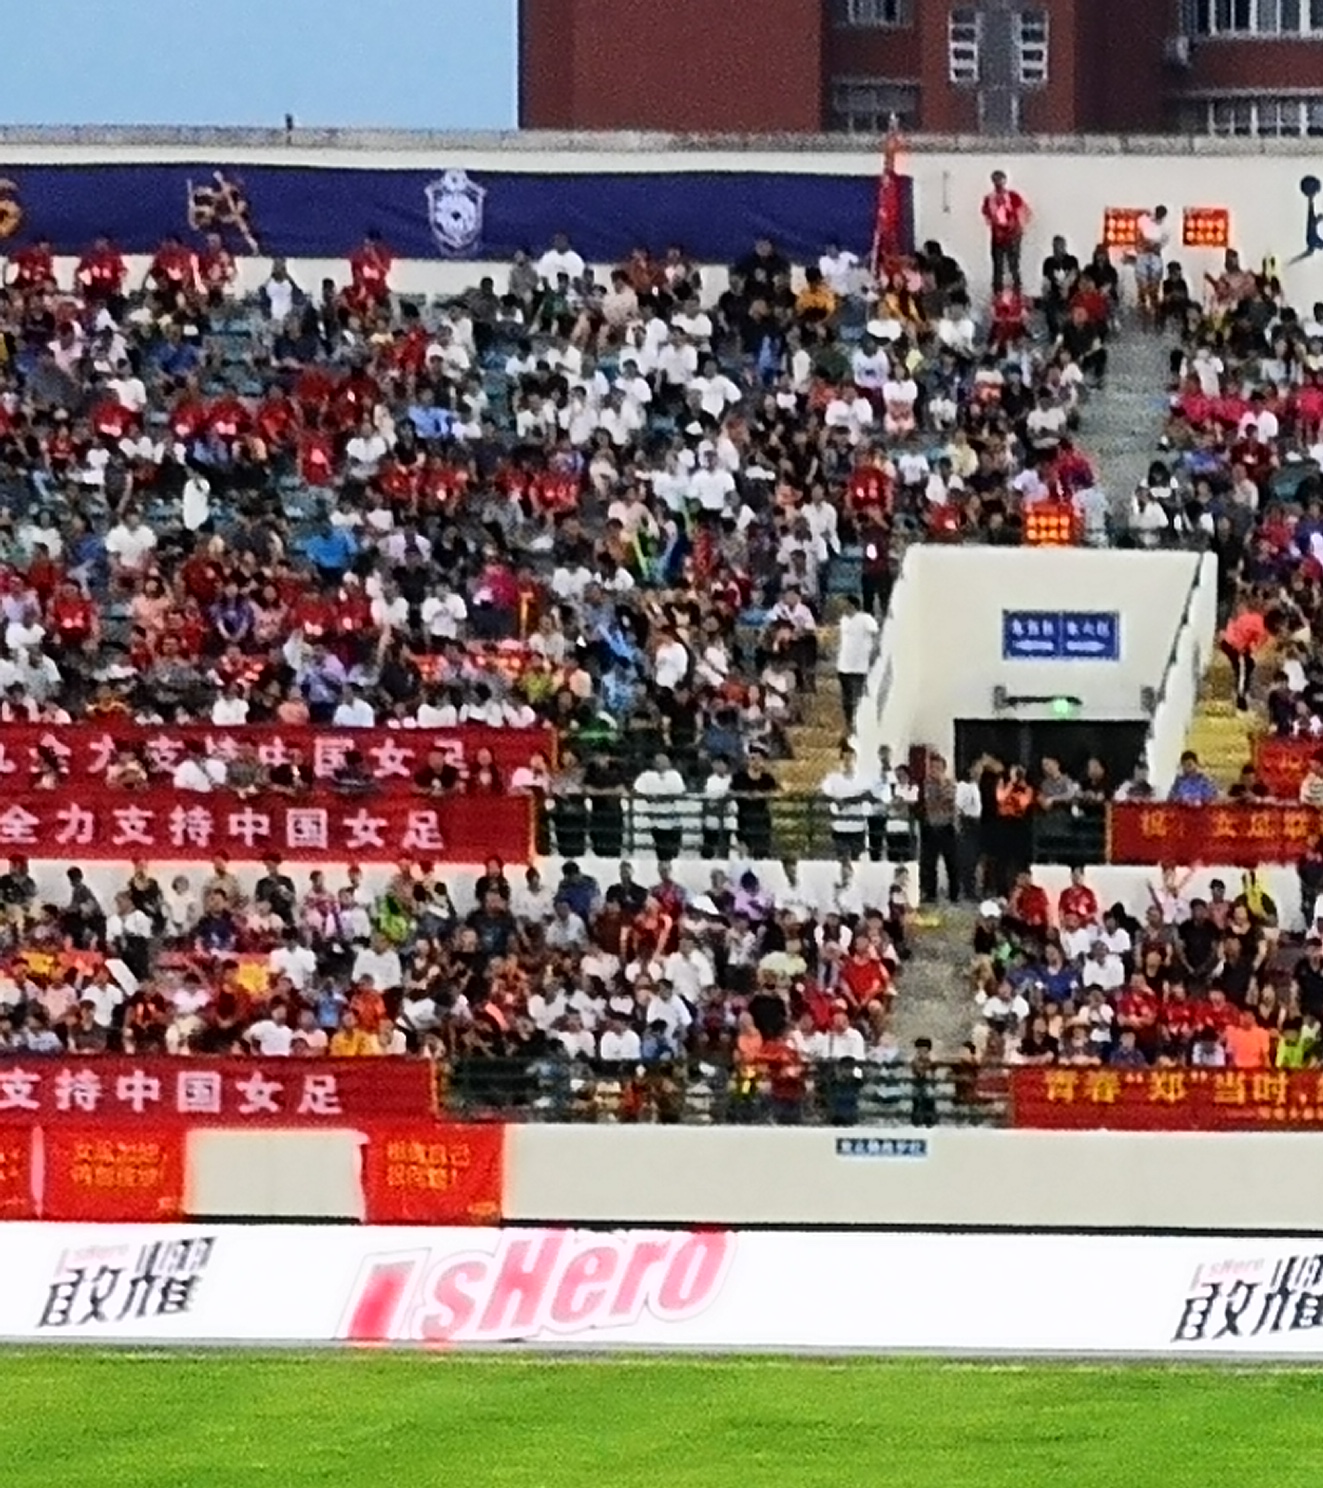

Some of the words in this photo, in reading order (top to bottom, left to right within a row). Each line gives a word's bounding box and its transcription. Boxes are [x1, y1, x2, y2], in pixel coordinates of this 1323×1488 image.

[0, 803, 446, 850] 全力支持中国女足
[0, 1067, 343, 1113] 支持中国女足
